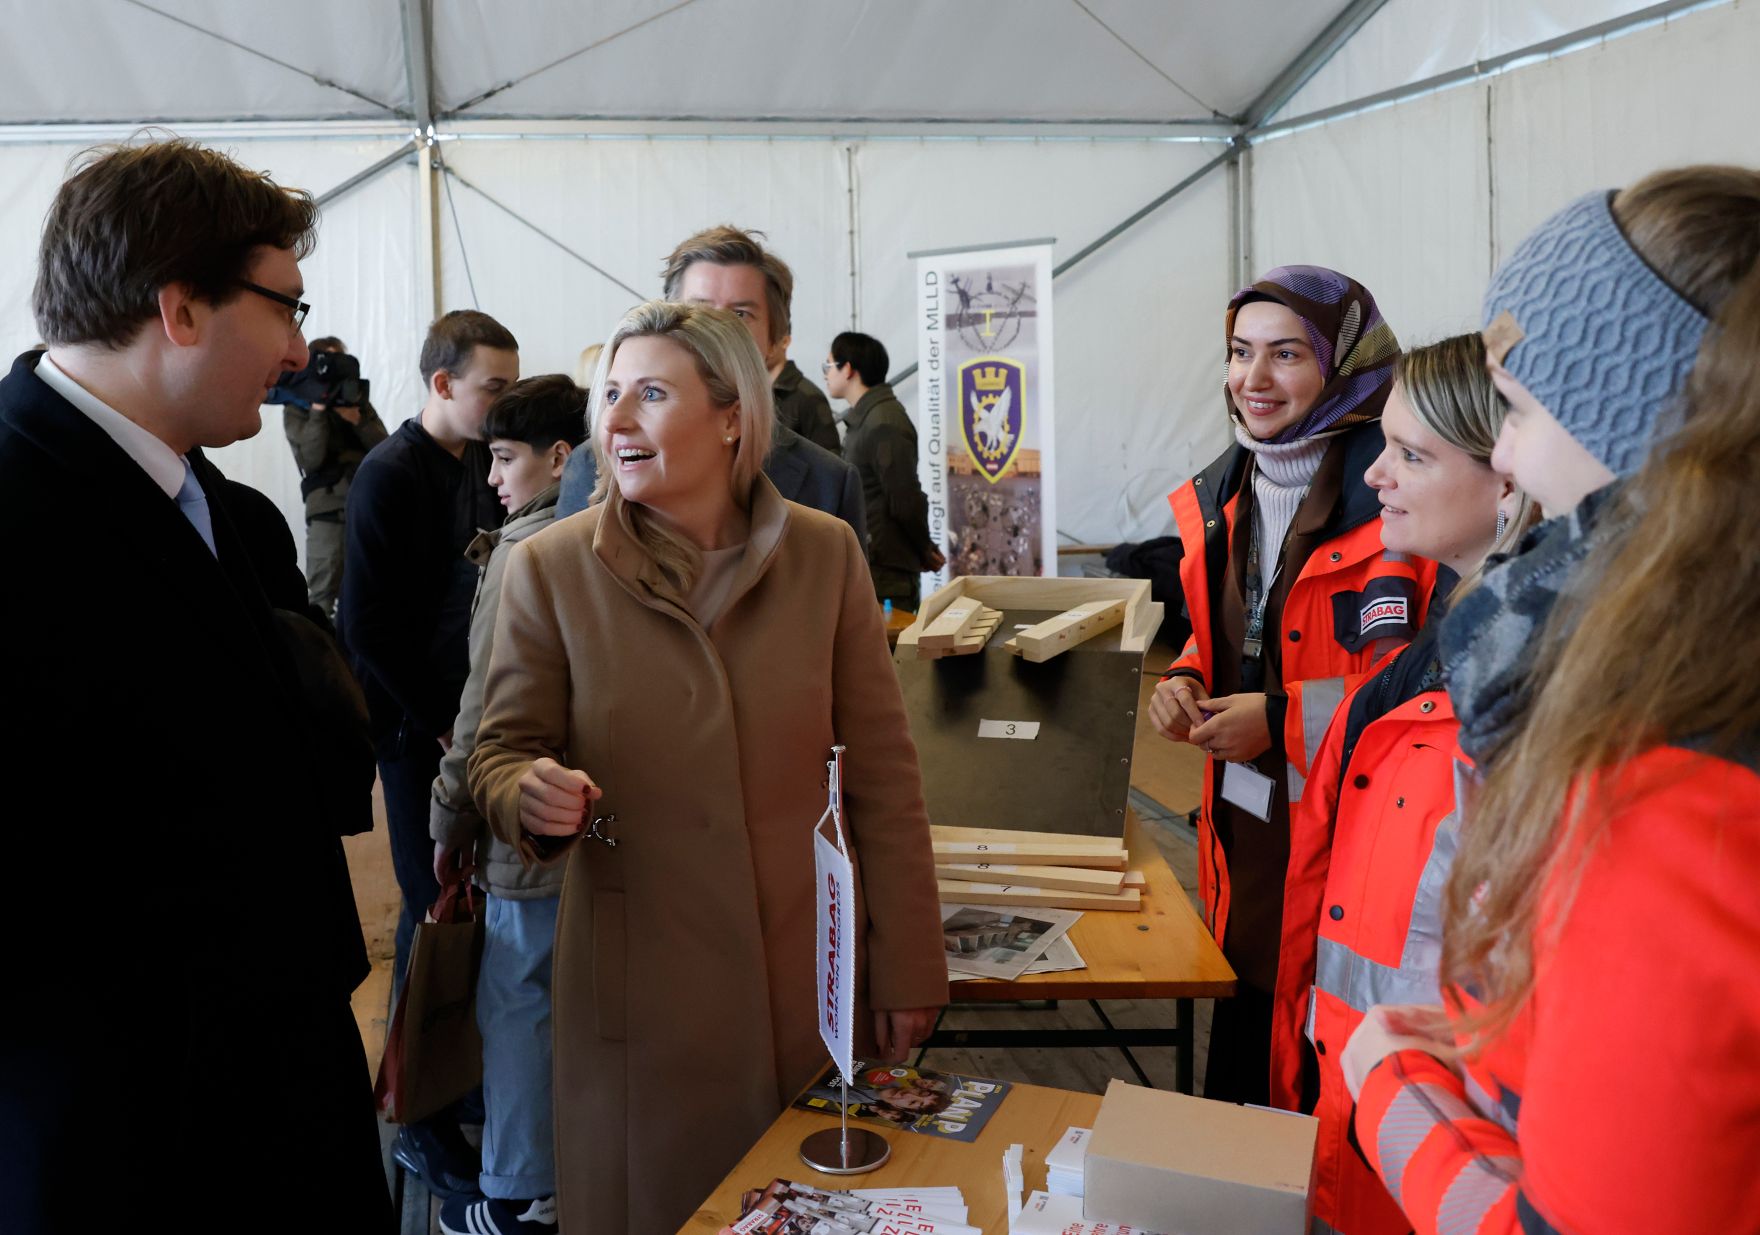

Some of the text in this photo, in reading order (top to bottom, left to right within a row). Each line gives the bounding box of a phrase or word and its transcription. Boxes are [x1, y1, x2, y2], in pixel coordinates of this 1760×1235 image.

[926, 271, 939, 331] MLLD
[927, 340, 940, 371] der
[928, 376, 941, 455] Qualität
[930, 462, 942, 494] auf
[1362, 605, 1405, 627] STRABAG
[1004, 723, 1016, 736] 3
[1001, 885, 1012, 893] 7
[827, 872, 837, 1033] STRABAG
[836, 966, 841, 989] ON
[937, 1081, 997, 1122] PLAN
